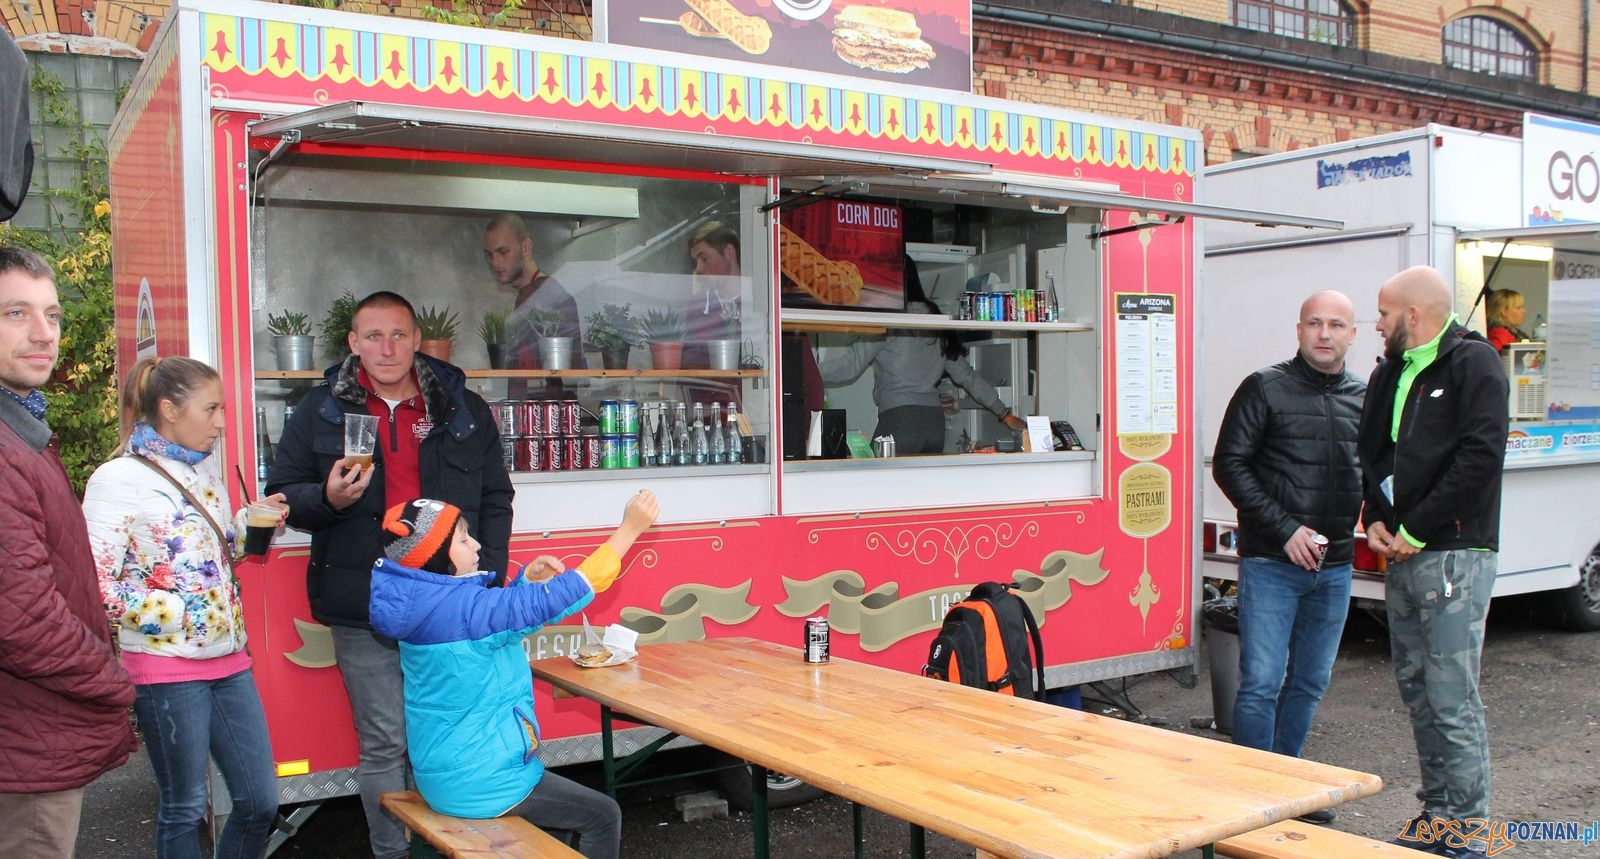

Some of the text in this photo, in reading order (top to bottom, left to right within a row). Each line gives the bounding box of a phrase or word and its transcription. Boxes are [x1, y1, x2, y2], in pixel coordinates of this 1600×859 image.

[837, 203, 898, 228] CORN DOG
[1139, 298, 1171, 306] ARIZONA
[1126, 491, 1165, 508] PASTRAMI
[520, 634, 581, 661] RESH
